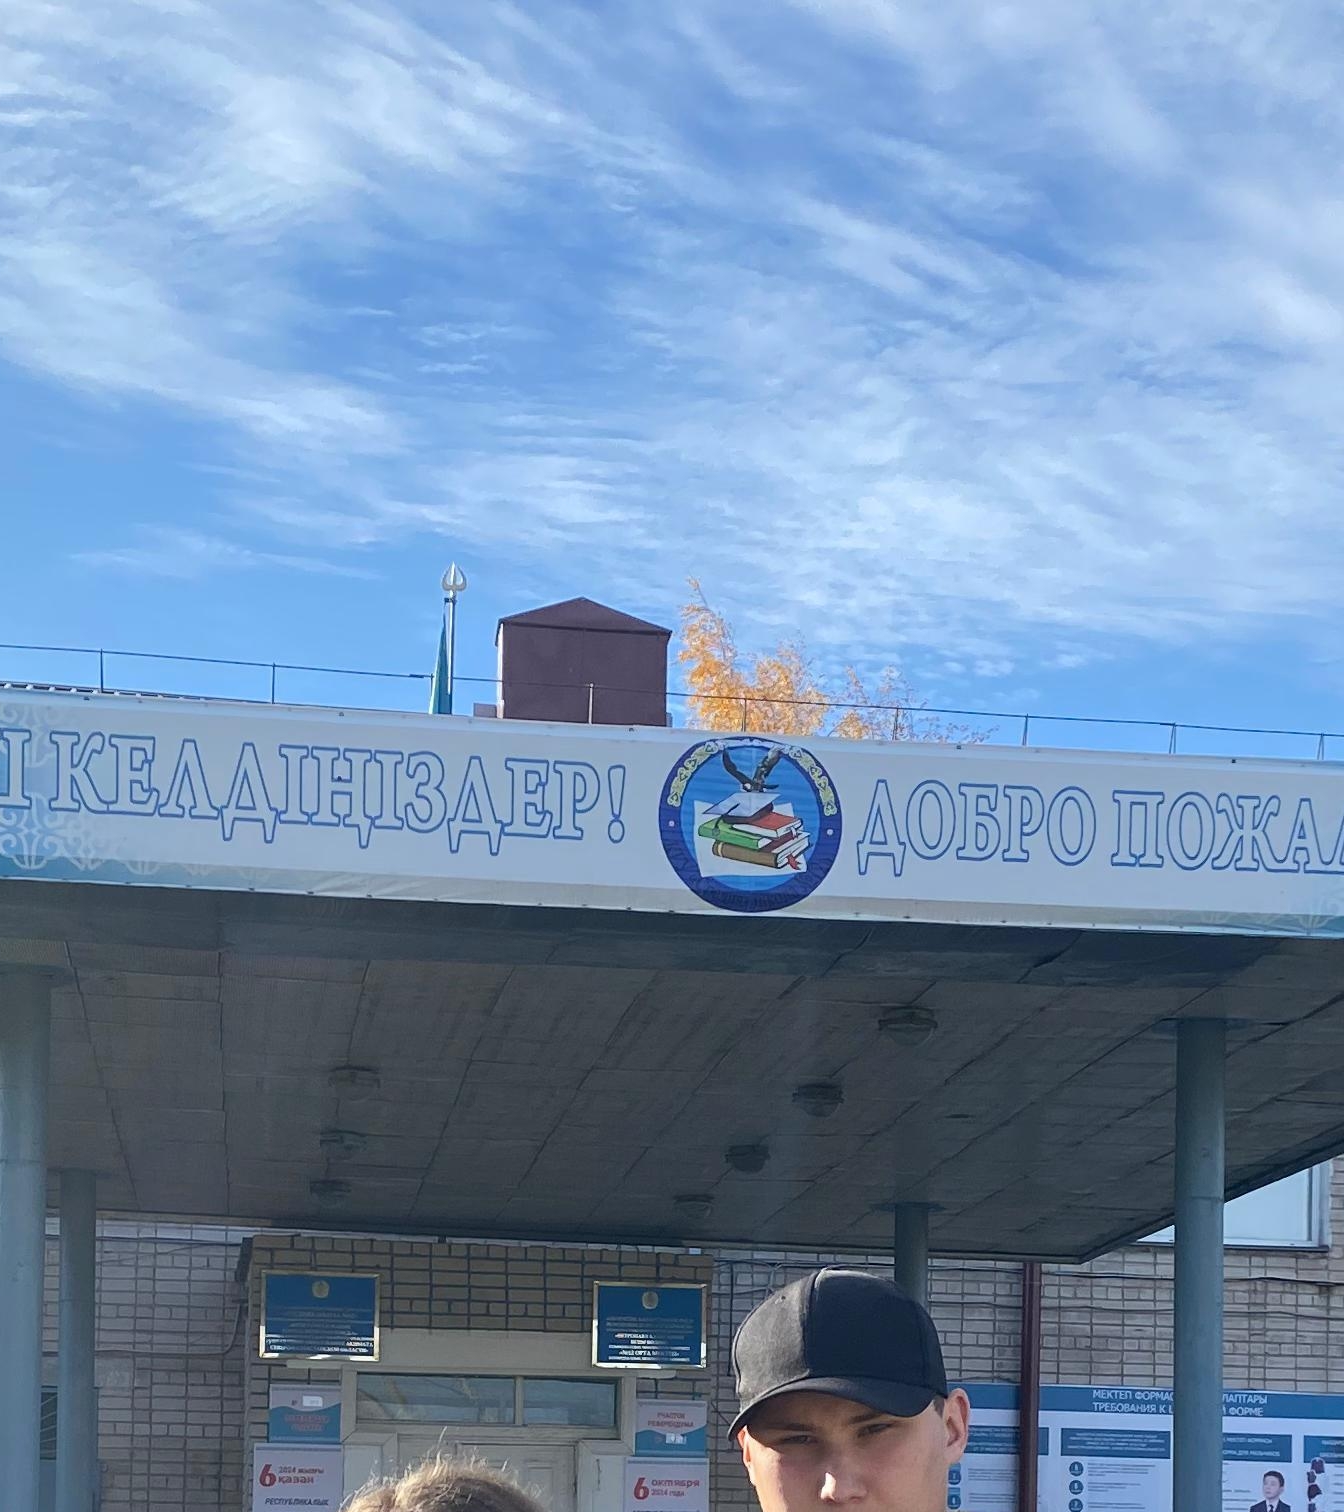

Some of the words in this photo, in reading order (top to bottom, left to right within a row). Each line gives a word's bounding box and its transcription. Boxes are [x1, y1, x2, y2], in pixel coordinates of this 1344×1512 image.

[49, 729, 627, 856] КЕЛДІҢІЗДЕР!
[855, 777, 1098, 877] ДОБРО
[1092, 1389, 1133, 1400] МЕКТЕП
[1092, 1402, 1157, 1414] ТРЕБОВАНИЯ
[1228, 1407, 1264, 1417] ФОРМЕ
[259, 1463, 277, 1488] 6
[633, 1477, 650, 1501] 6
[651, 1479, 700, 1489] октября
